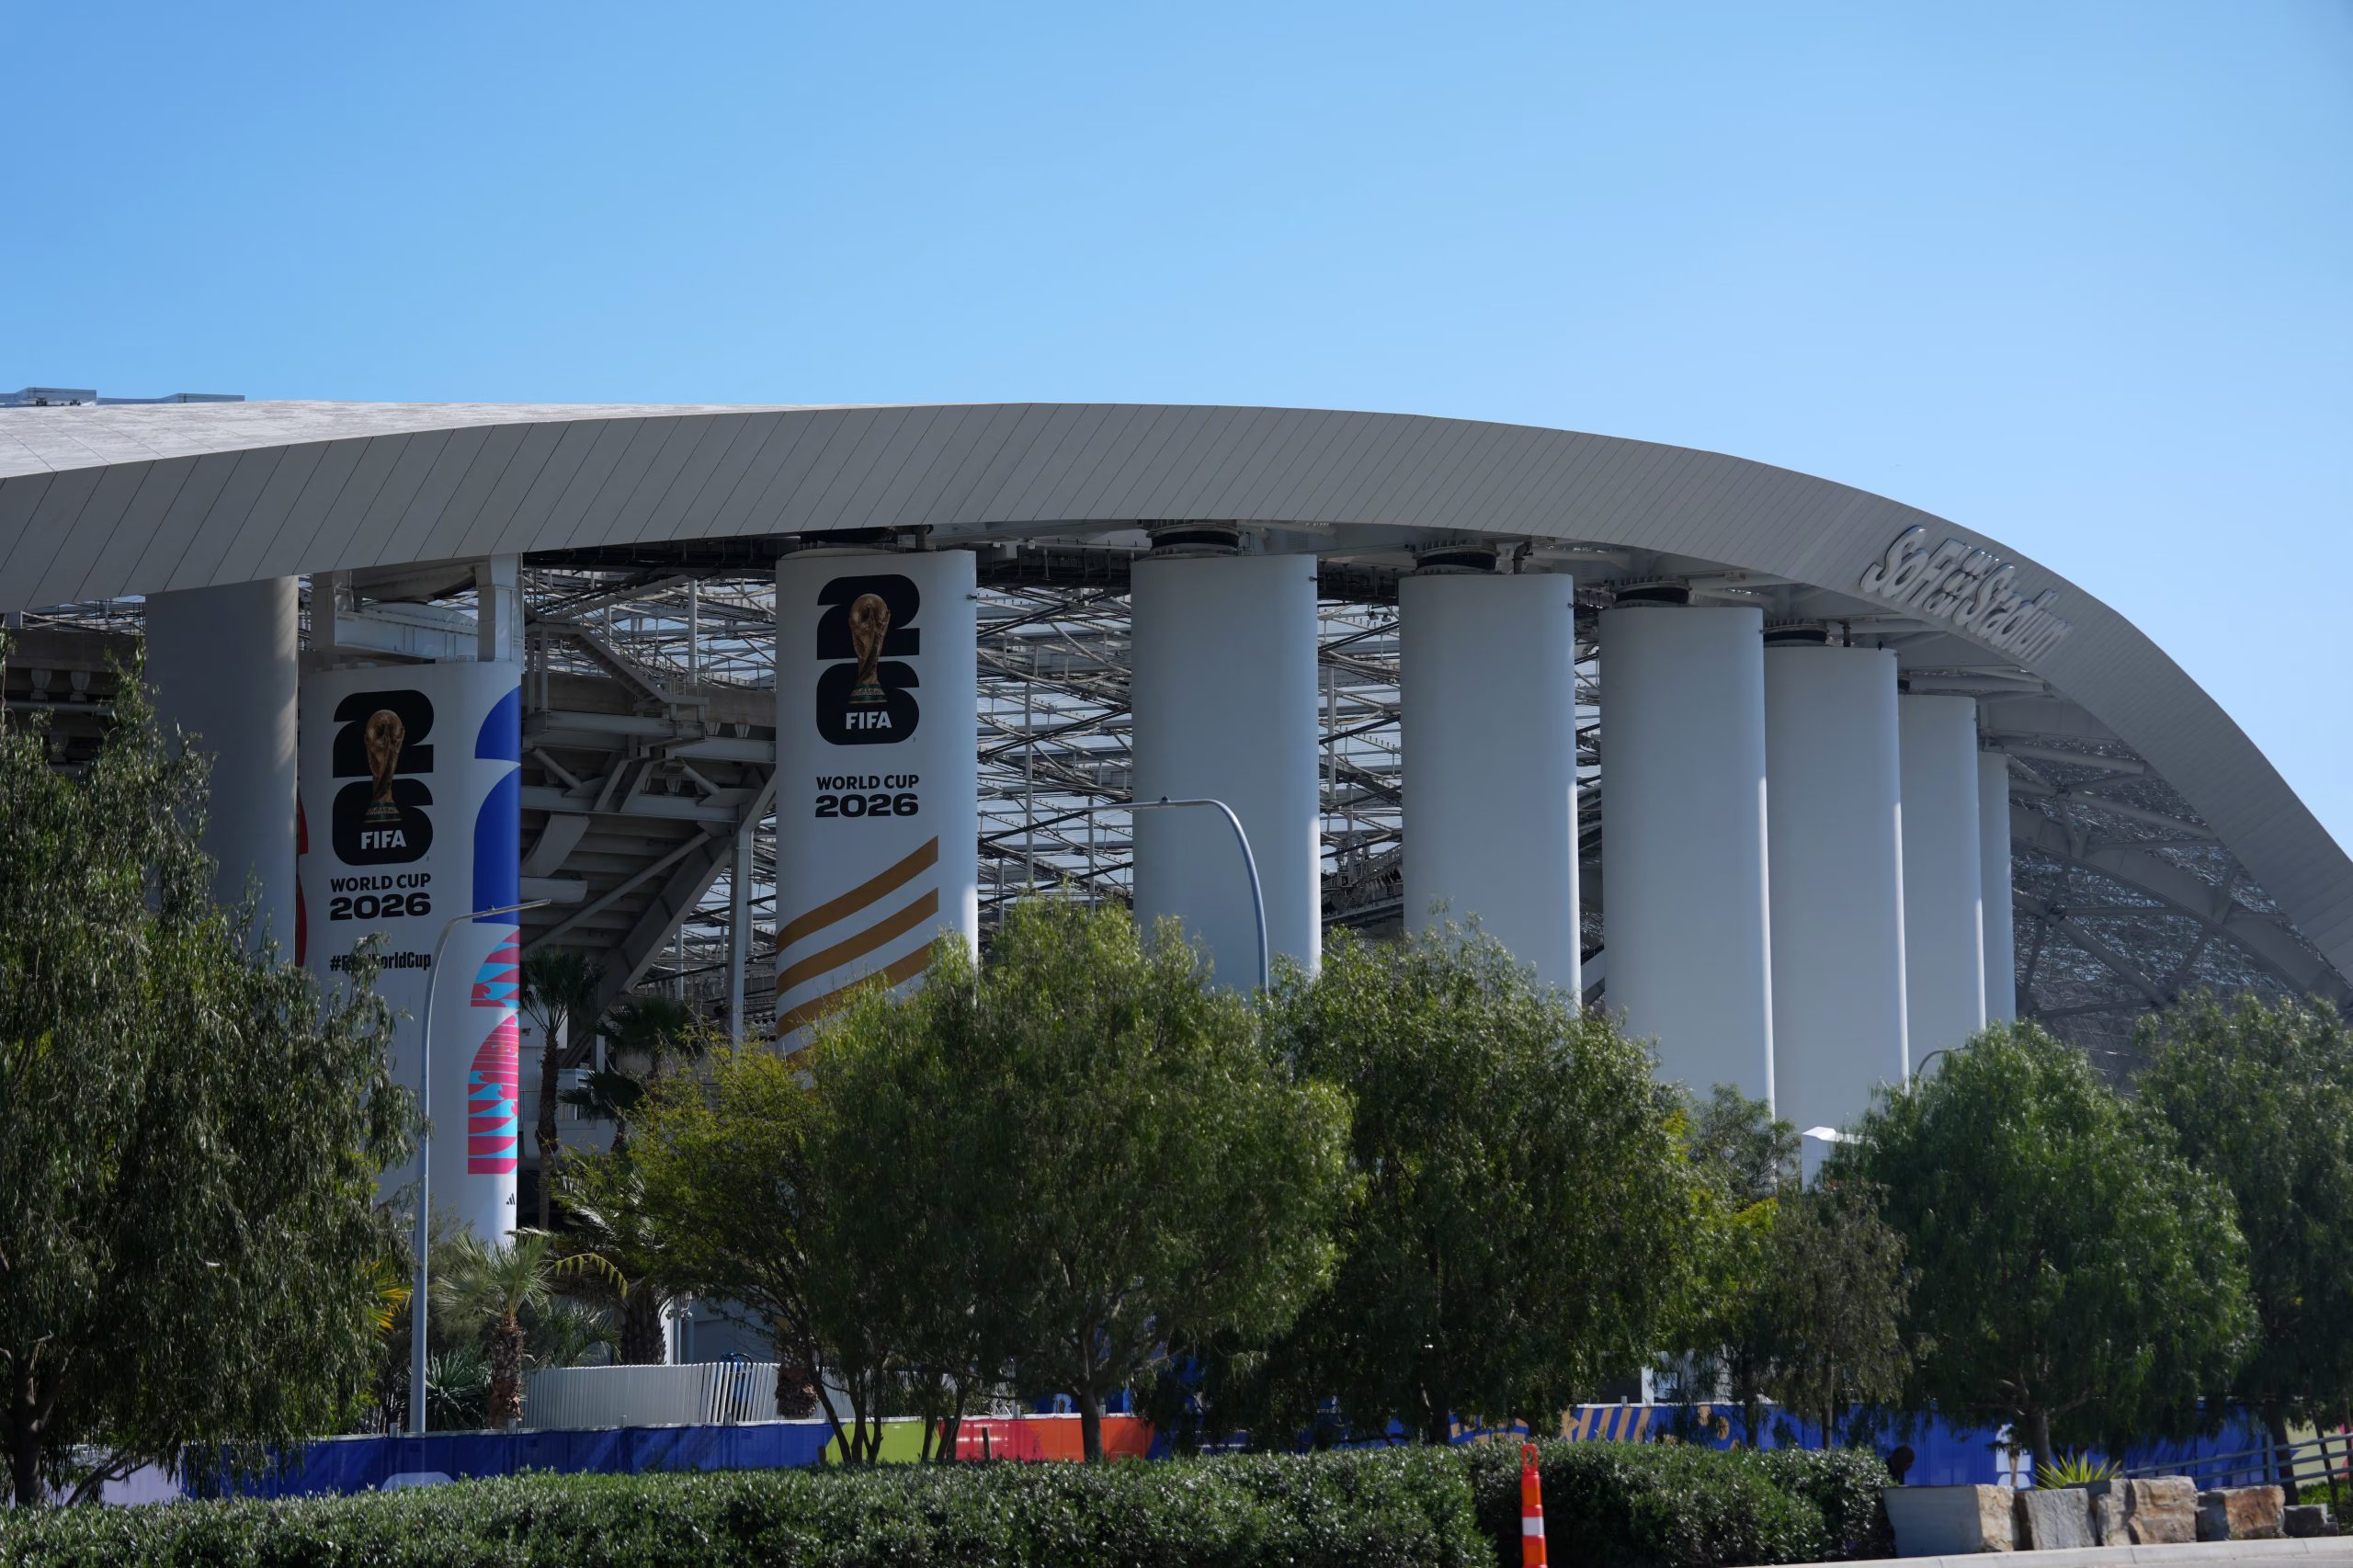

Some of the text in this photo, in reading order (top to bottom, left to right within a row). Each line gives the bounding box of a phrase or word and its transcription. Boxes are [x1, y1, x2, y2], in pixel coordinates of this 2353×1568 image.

[846, 711, 892, 730] FIFA
[816, 775, 919, 790] WORLD CUP
[815, 793, 918, 817] 2026
[361, 830, 406, 849] FIFA
[330, 873, 431, 892] WORLD CUP
[330, 892, 431, 920] 2026
